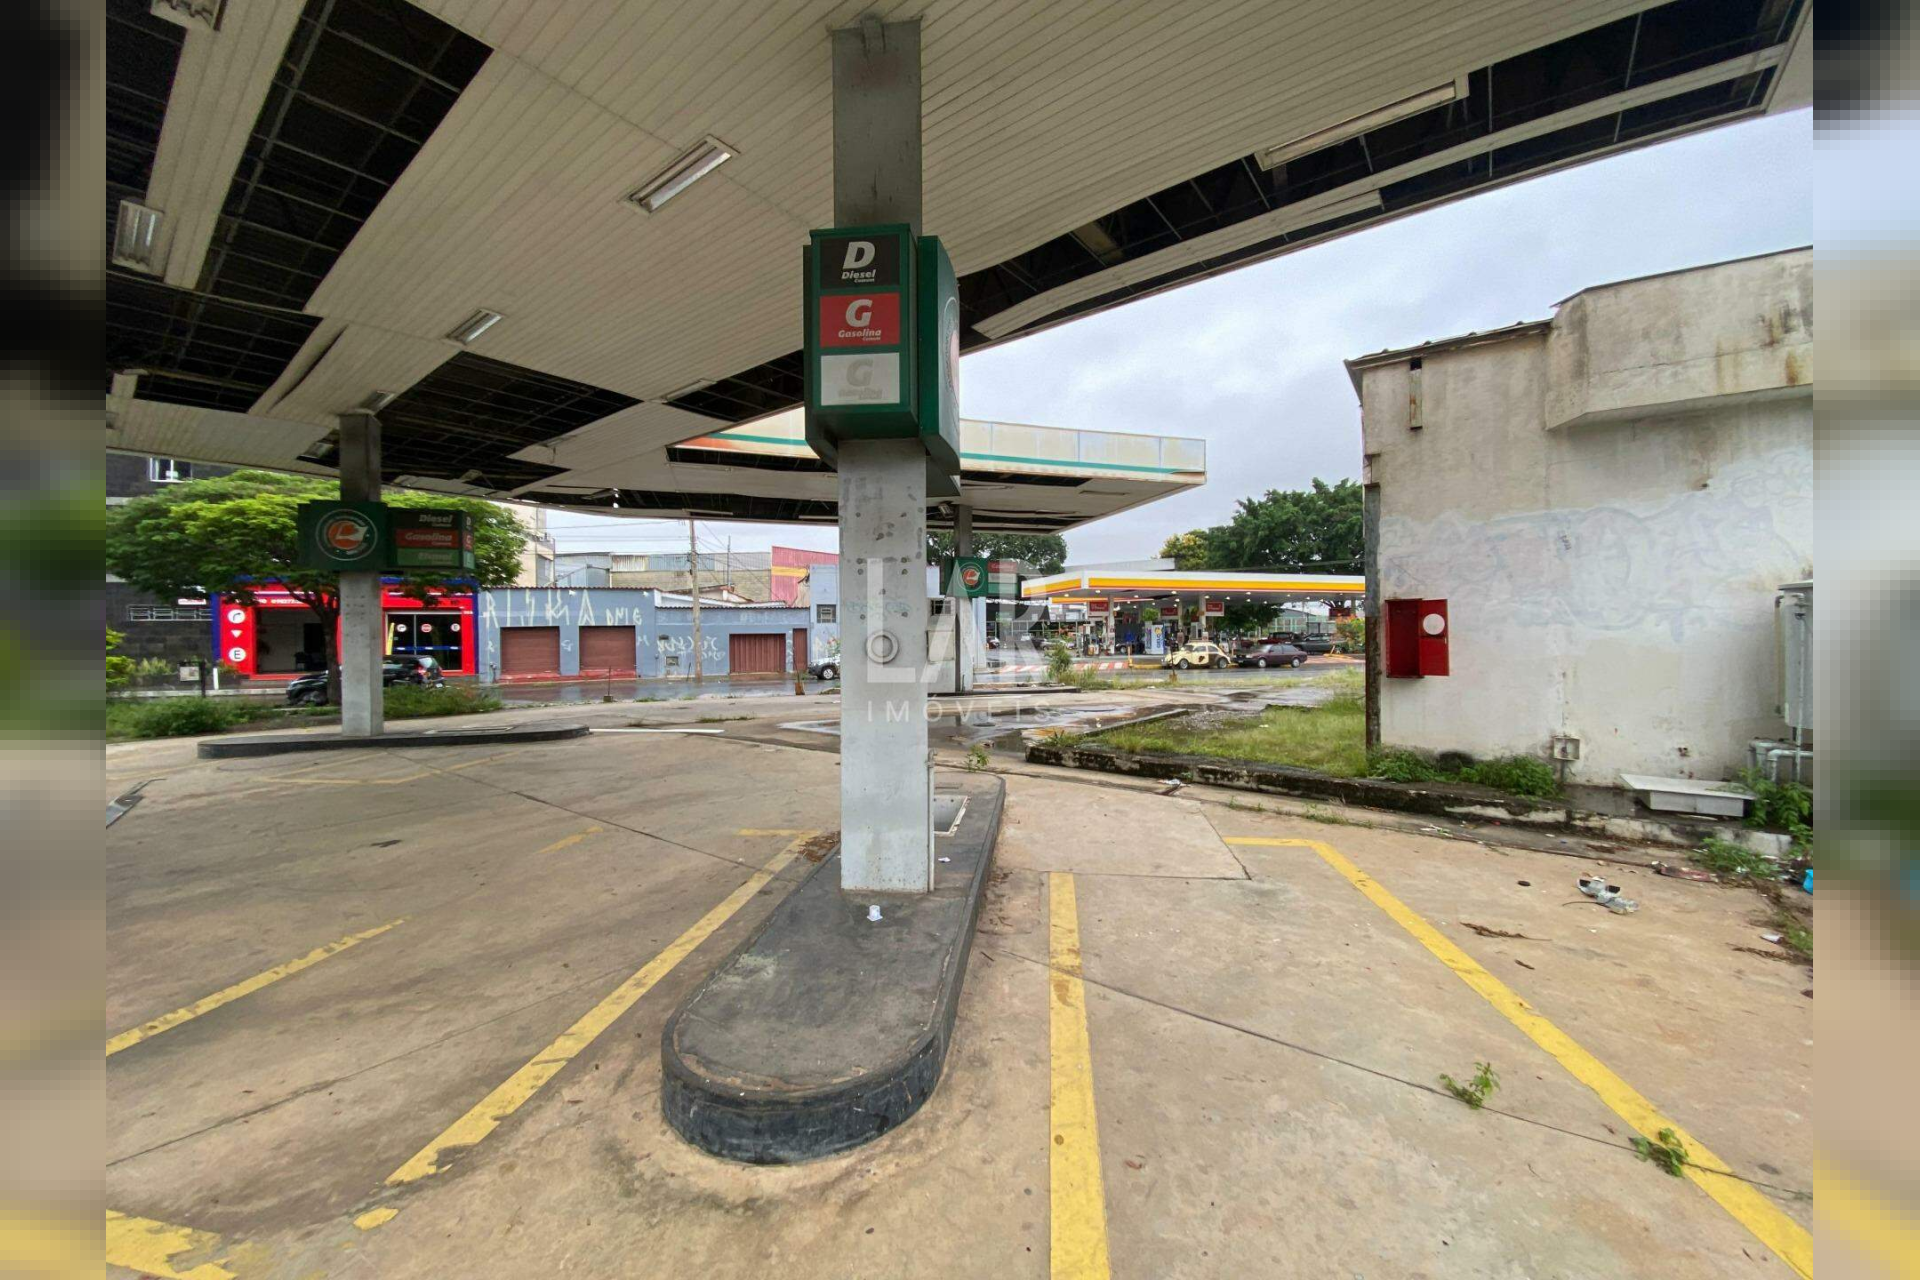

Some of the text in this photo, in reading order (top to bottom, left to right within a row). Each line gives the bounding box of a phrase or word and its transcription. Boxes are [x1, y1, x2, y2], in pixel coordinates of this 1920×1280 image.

[842, 240, 876, 270] D
[841, 269, 877, 280] Diesel
[845, 298, 873, 328] G
[838, 328, 882, 338] Gasolina
[846, 358, 873, 387] G
[419, 514, 453, 523] Diesel
[405, 532, 452, 542] Gasolina
